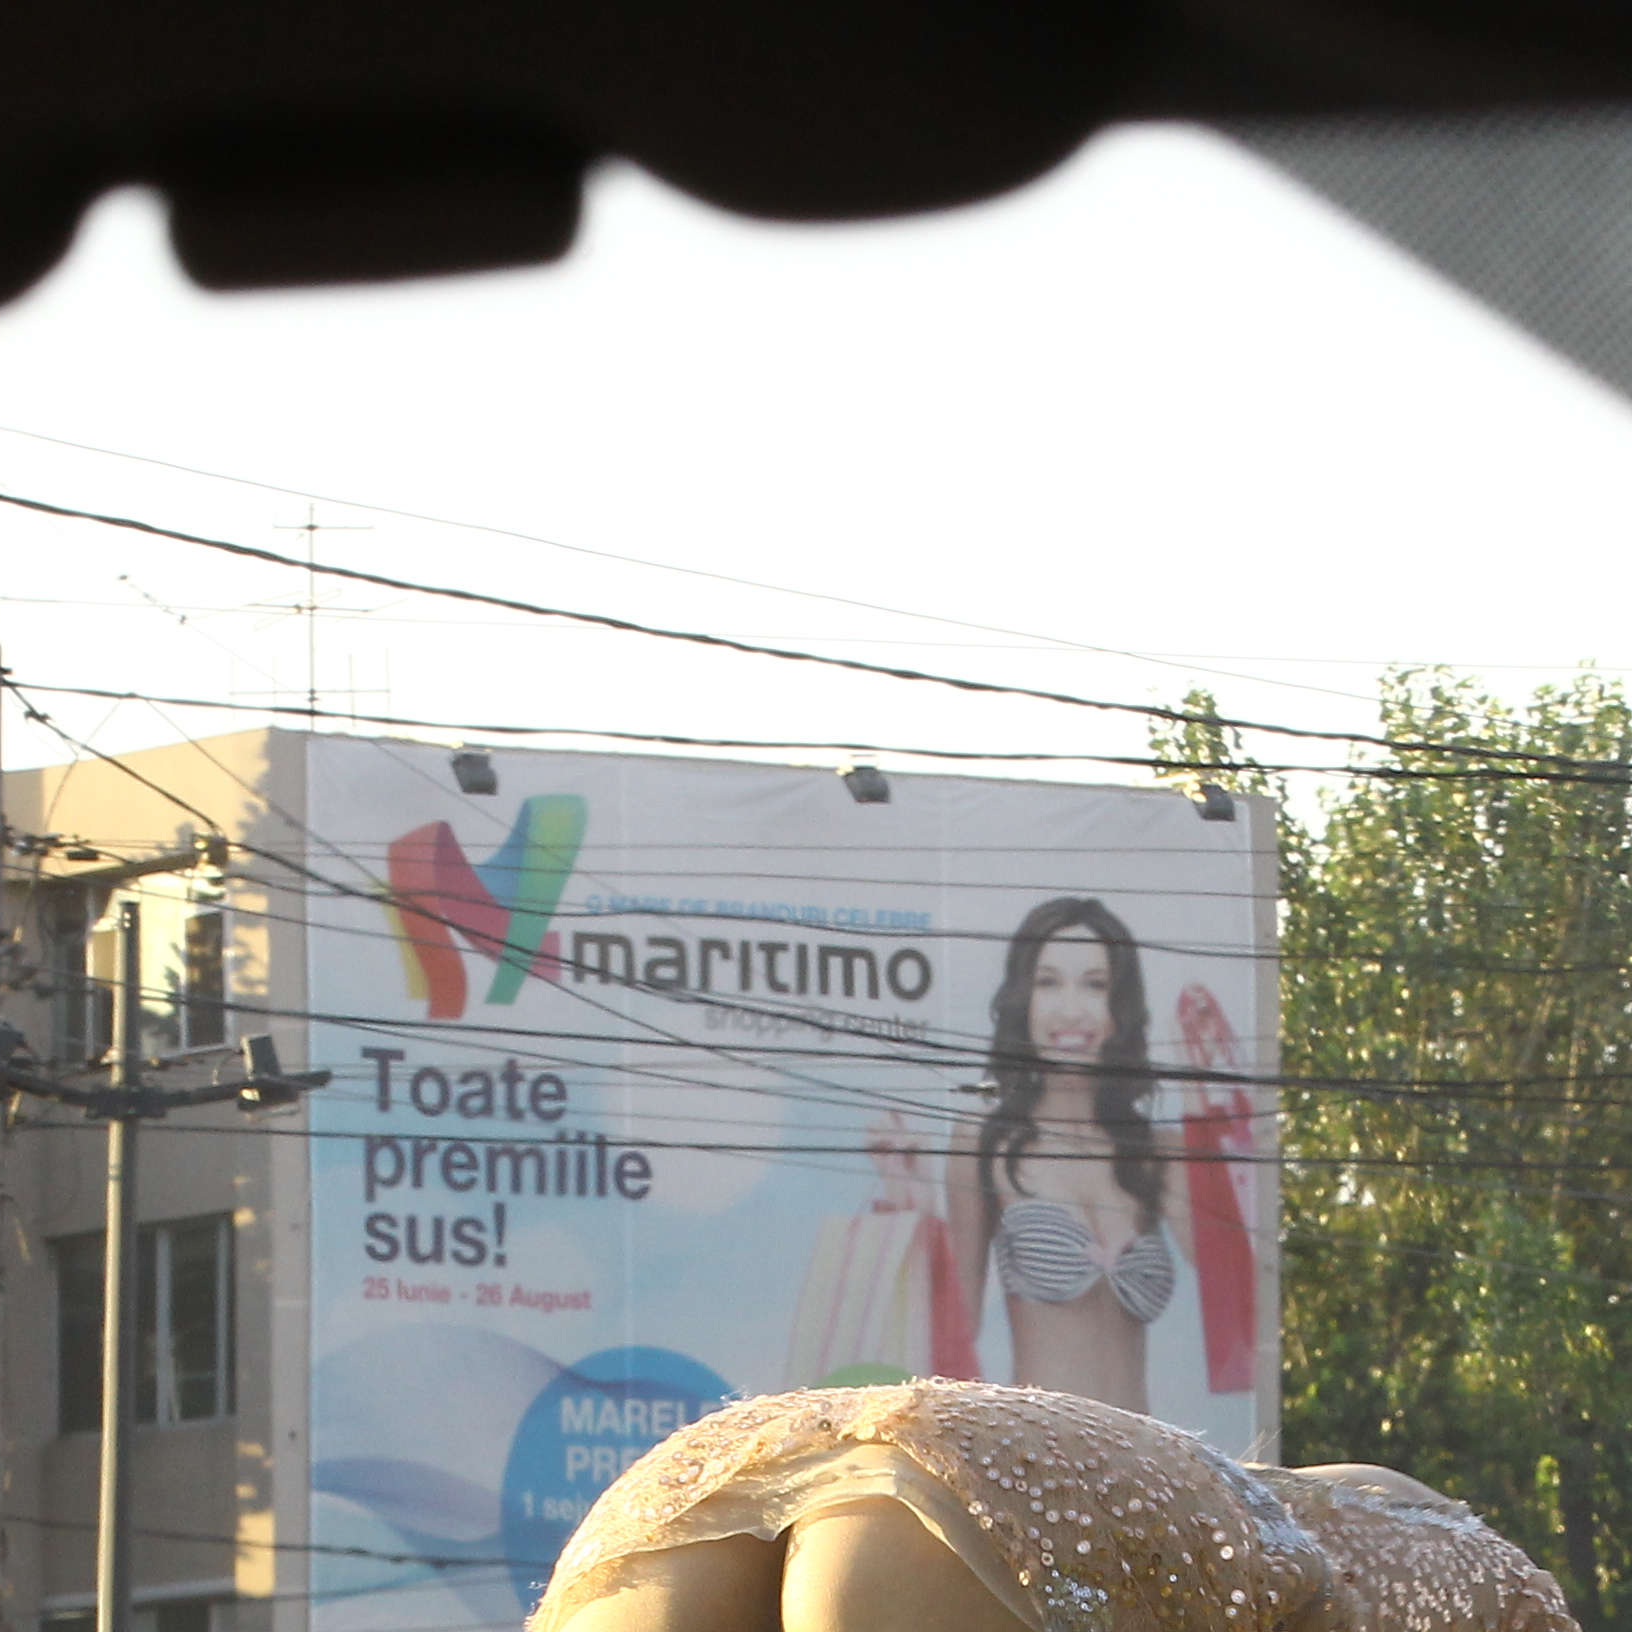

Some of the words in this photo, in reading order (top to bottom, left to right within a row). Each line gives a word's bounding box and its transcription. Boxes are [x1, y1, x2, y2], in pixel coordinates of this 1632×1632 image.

[572, 931, 932, 1003] maritimo
[361, 1045, 569, 1123] Toate
[364, 1130, 654, 1202] premiile
[364, 1202, 508, 1267] sus!
[363, 1276, 390, 1300] 25
[398, 1278, 452, 1304] Iunie
[476, 1282, 504, 1307] 26
[508, 1284, 594, 1314] August
